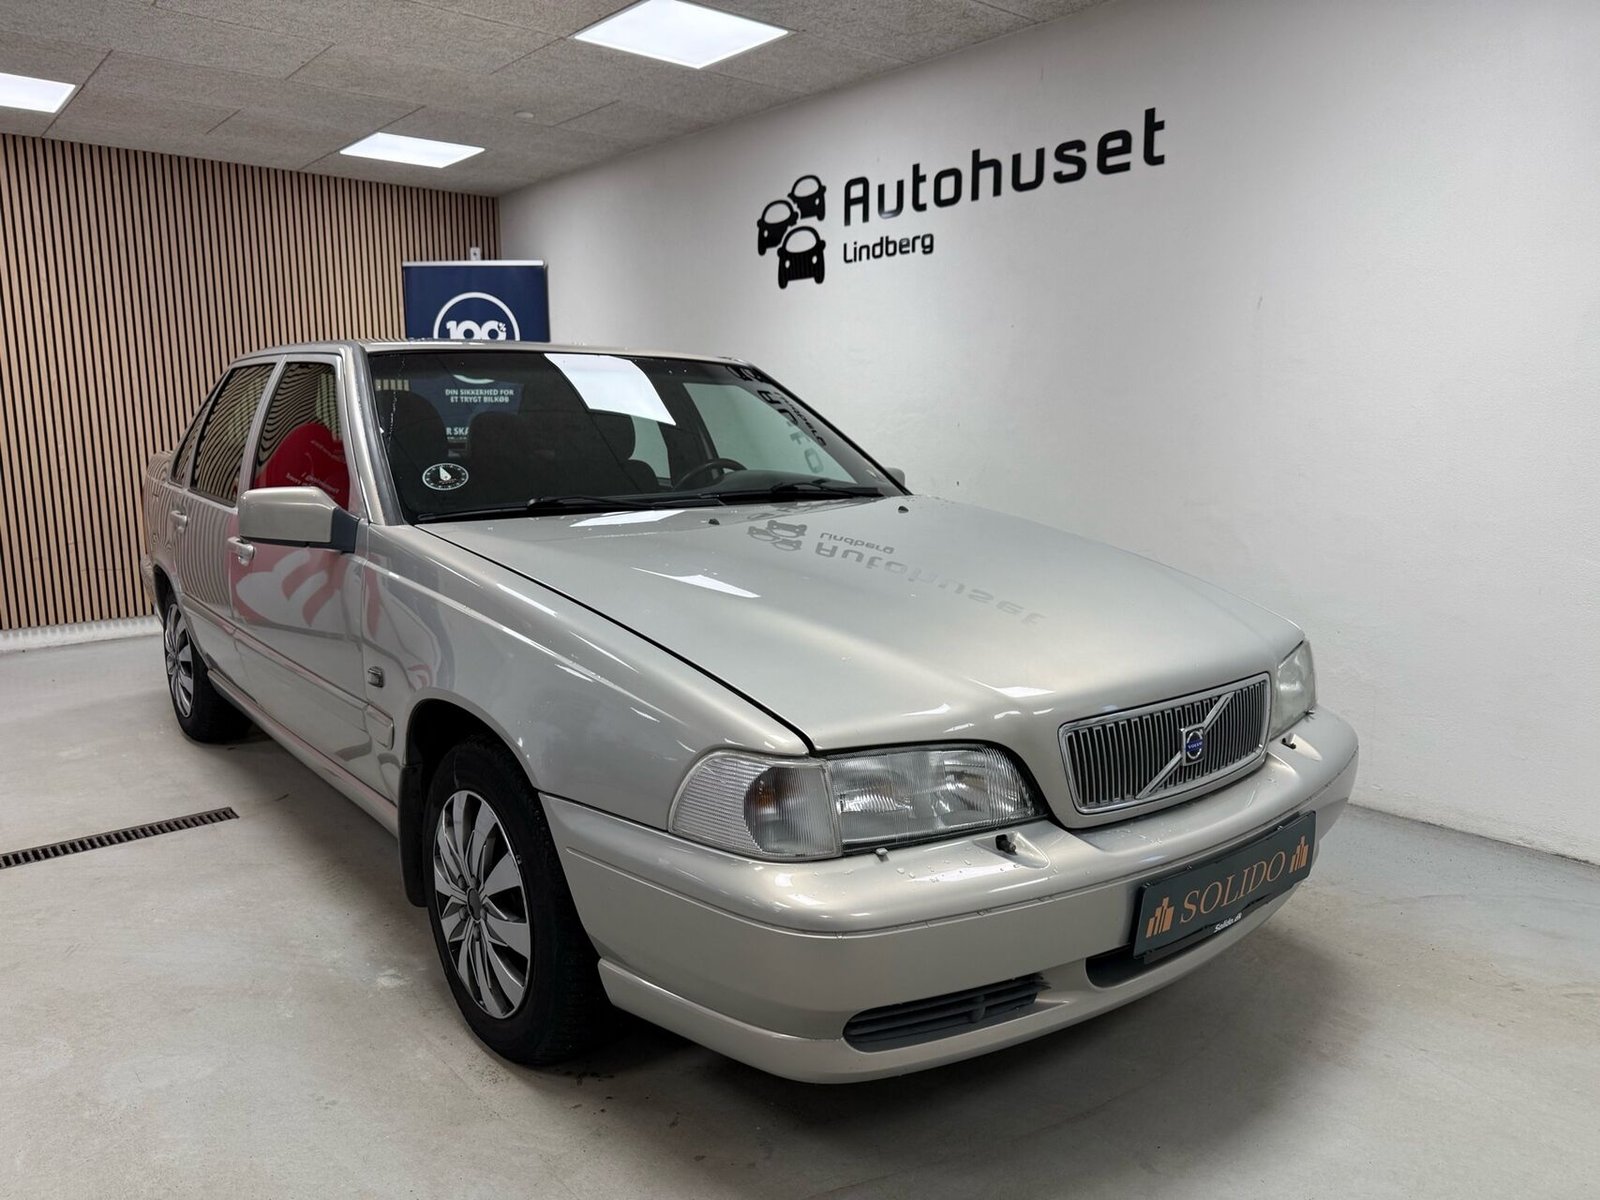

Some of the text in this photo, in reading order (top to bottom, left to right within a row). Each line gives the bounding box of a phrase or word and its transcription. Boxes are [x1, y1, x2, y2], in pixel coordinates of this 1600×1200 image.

[843, 107, 1166, 227] Autohuset
[843, 233, 935, 264] Lindberg
[445, 388, 459, 396] DIN
[1179, 851, 1286, 924] SOLIDO
